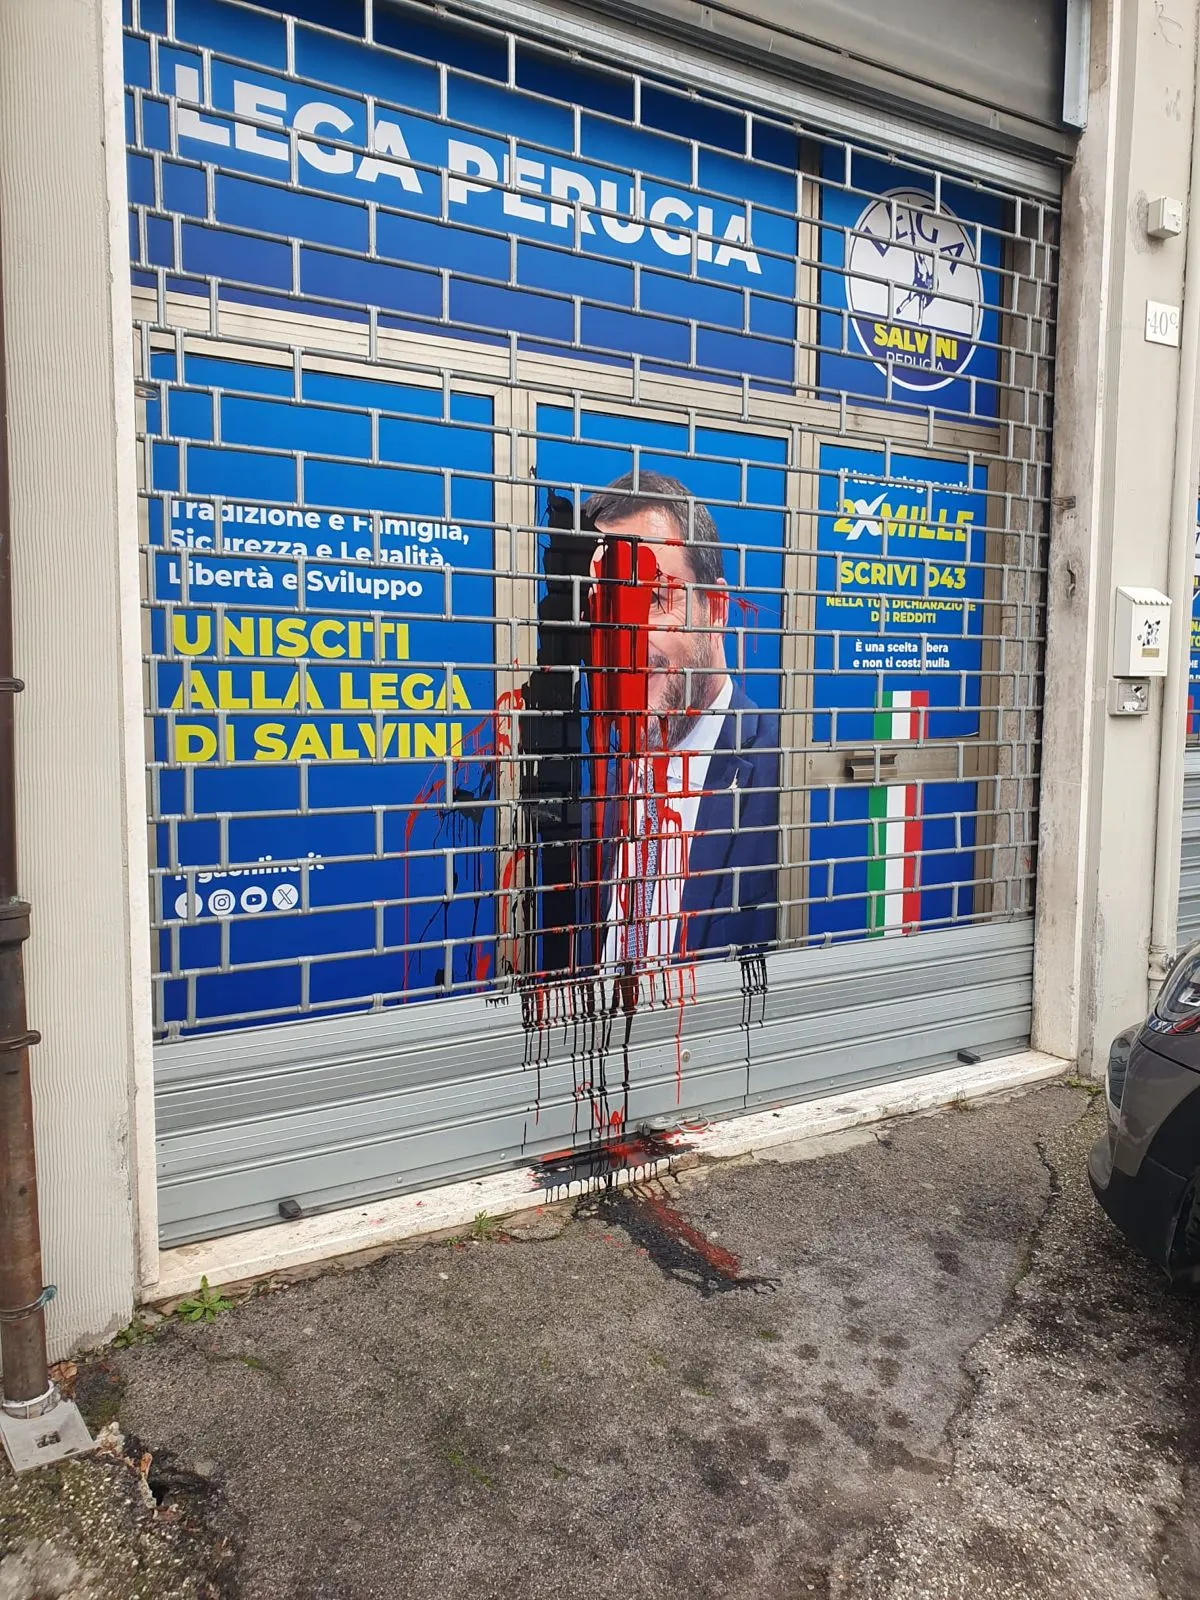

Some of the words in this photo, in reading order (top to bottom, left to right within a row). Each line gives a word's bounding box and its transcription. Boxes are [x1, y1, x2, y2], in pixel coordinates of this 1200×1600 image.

[175, 63, 422, 195] LEGA
[448, 139, 762, 274] PERUGIA
[873, 323, 957, 360] SALVNI
[328, 514, 345, 531] e
[316, 544, 333, 558] e
[169, 561, 274, 589] Libertà
[282, 572, 298, 590] e
[306, 569, 423, 601] Sviluppo
[840, 560, 917, 587] SCRIVI
[927, 567, 966, 590] D43
[826, 596, 864, 607] NELLA
[871, 611, 890, 622] DI
[892, 612, 937, 624] REDDITI
[172, 614, 409, 659] UNISCITI
[855, 639, 863, 652] È
[865, 643, 885, 652] una
[887, 641, 918, 653] scelta
[853, 659, 860, 668] e
[862, 659, 883, 668] non
[885, 656, 894, 668] ti
[170, 670, 325, 709] ALLA
[340, 672, 472, 710] LEGA
[174, 724, 235, 762] DI
[253, 722, 462, 760] SALVINI
